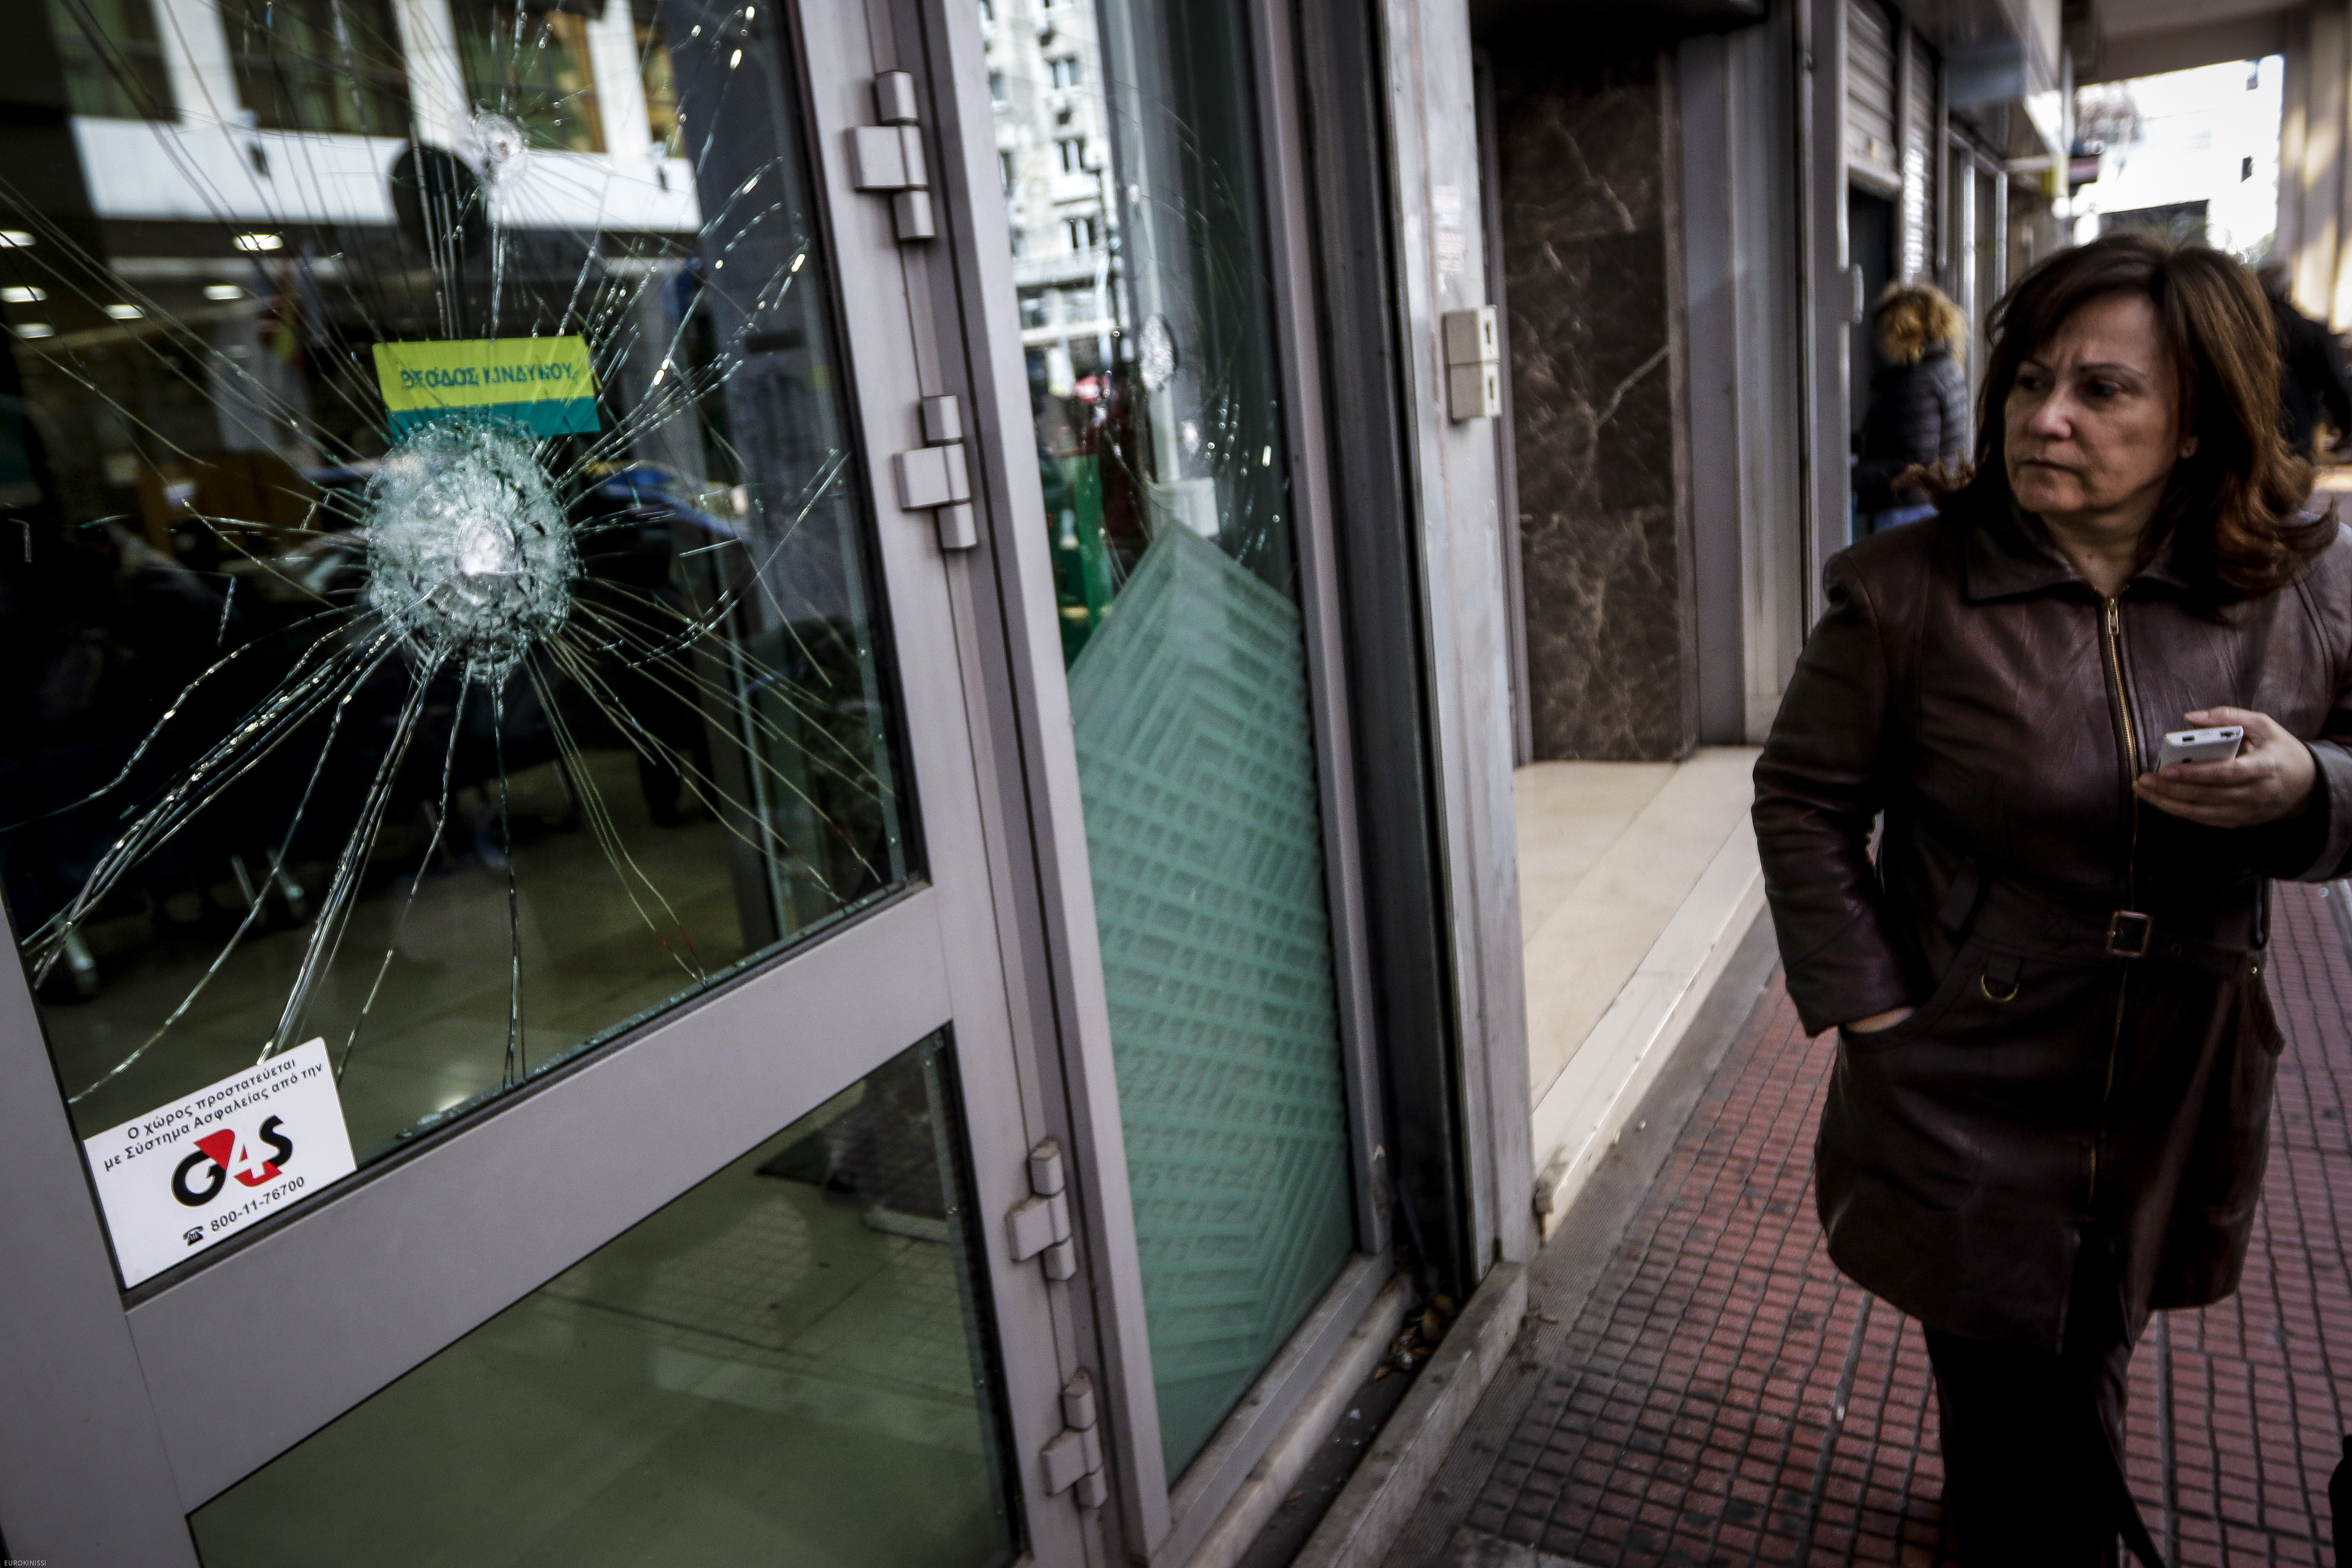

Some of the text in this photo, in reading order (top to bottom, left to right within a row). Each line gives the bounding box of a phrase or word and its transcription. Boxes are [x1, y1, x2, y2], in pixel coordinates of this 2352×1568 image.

[103, 1063, 322, 1173] με Σύστημα Ασφαλείας από την
[127, 1059, 296, 1139] Ο χώρος προστατεύεται
[170, 1114, 293, 1207] G4S
[210, 1176, 304, 1232] 800-11-76700
